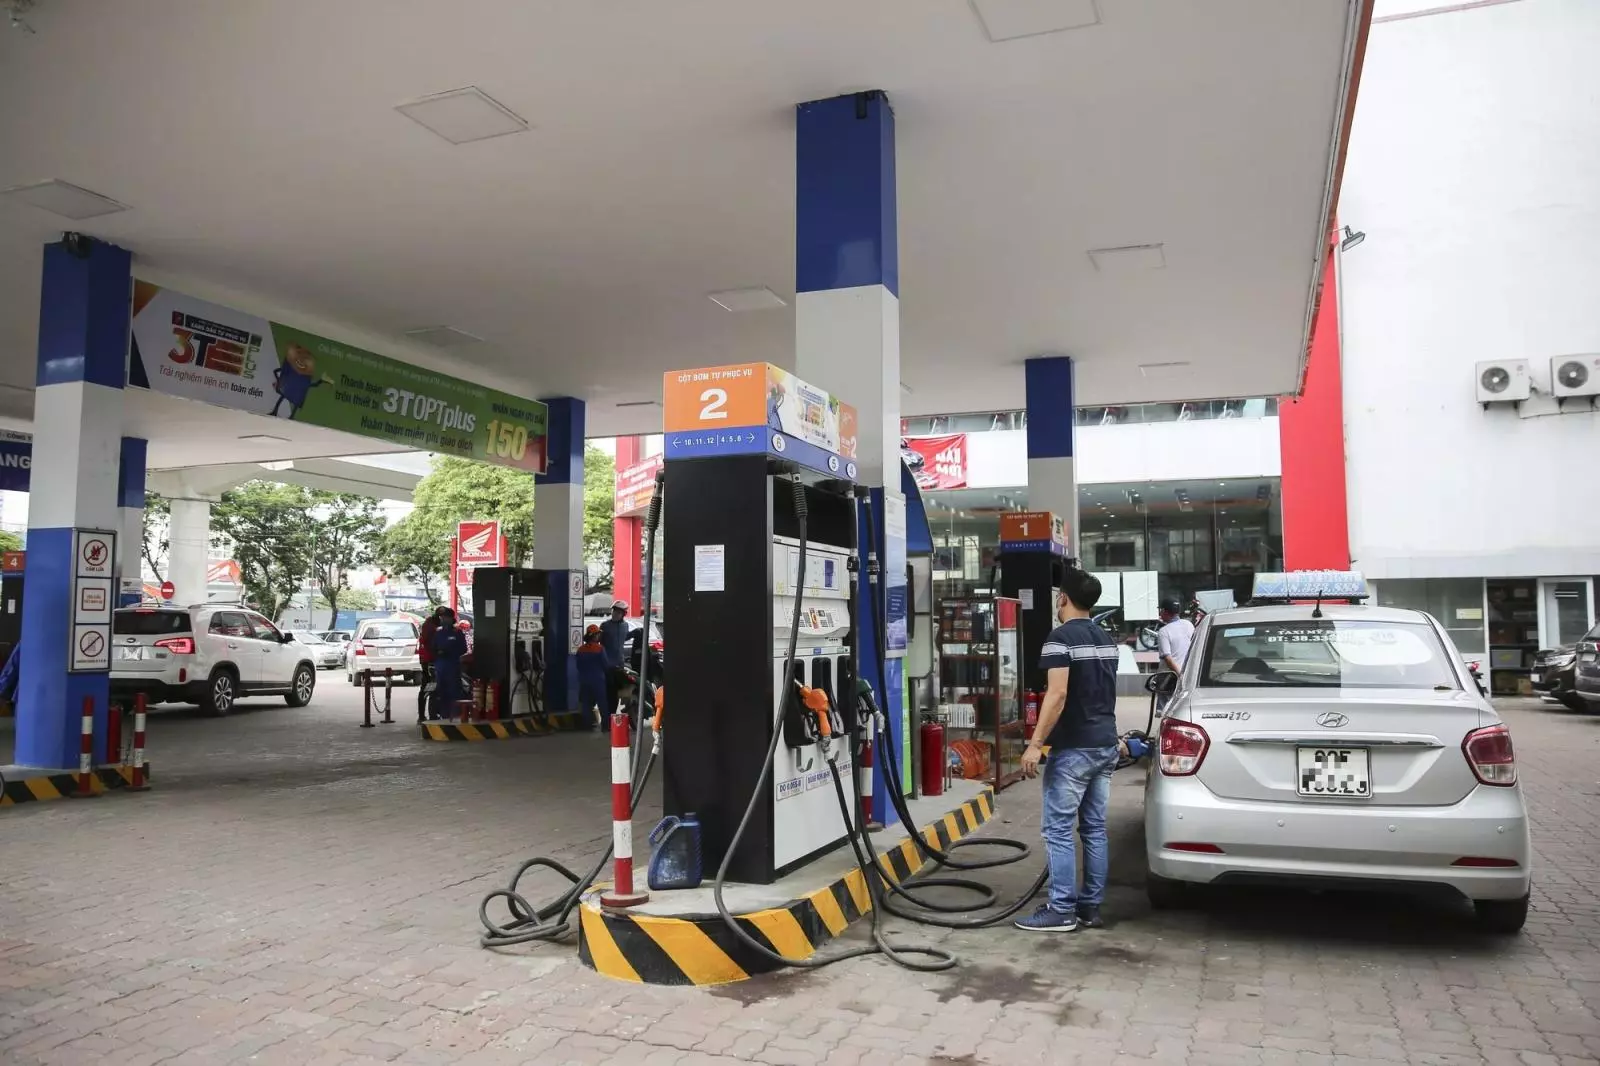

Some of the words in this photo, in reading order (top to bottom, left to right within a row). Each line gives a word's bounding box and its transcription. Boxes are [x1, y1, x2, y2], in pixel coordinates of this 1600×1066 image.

[699, 388, 728, 420] 2
[486, 420, 528, 461] 150
[775, 436, 783, 449] 6
[830, 457, 838, 470] 5
[1019, 522, 1029, 536] 1
[10, 556, 18, 567] 4
[1229, 711, 1251, 721] i10
